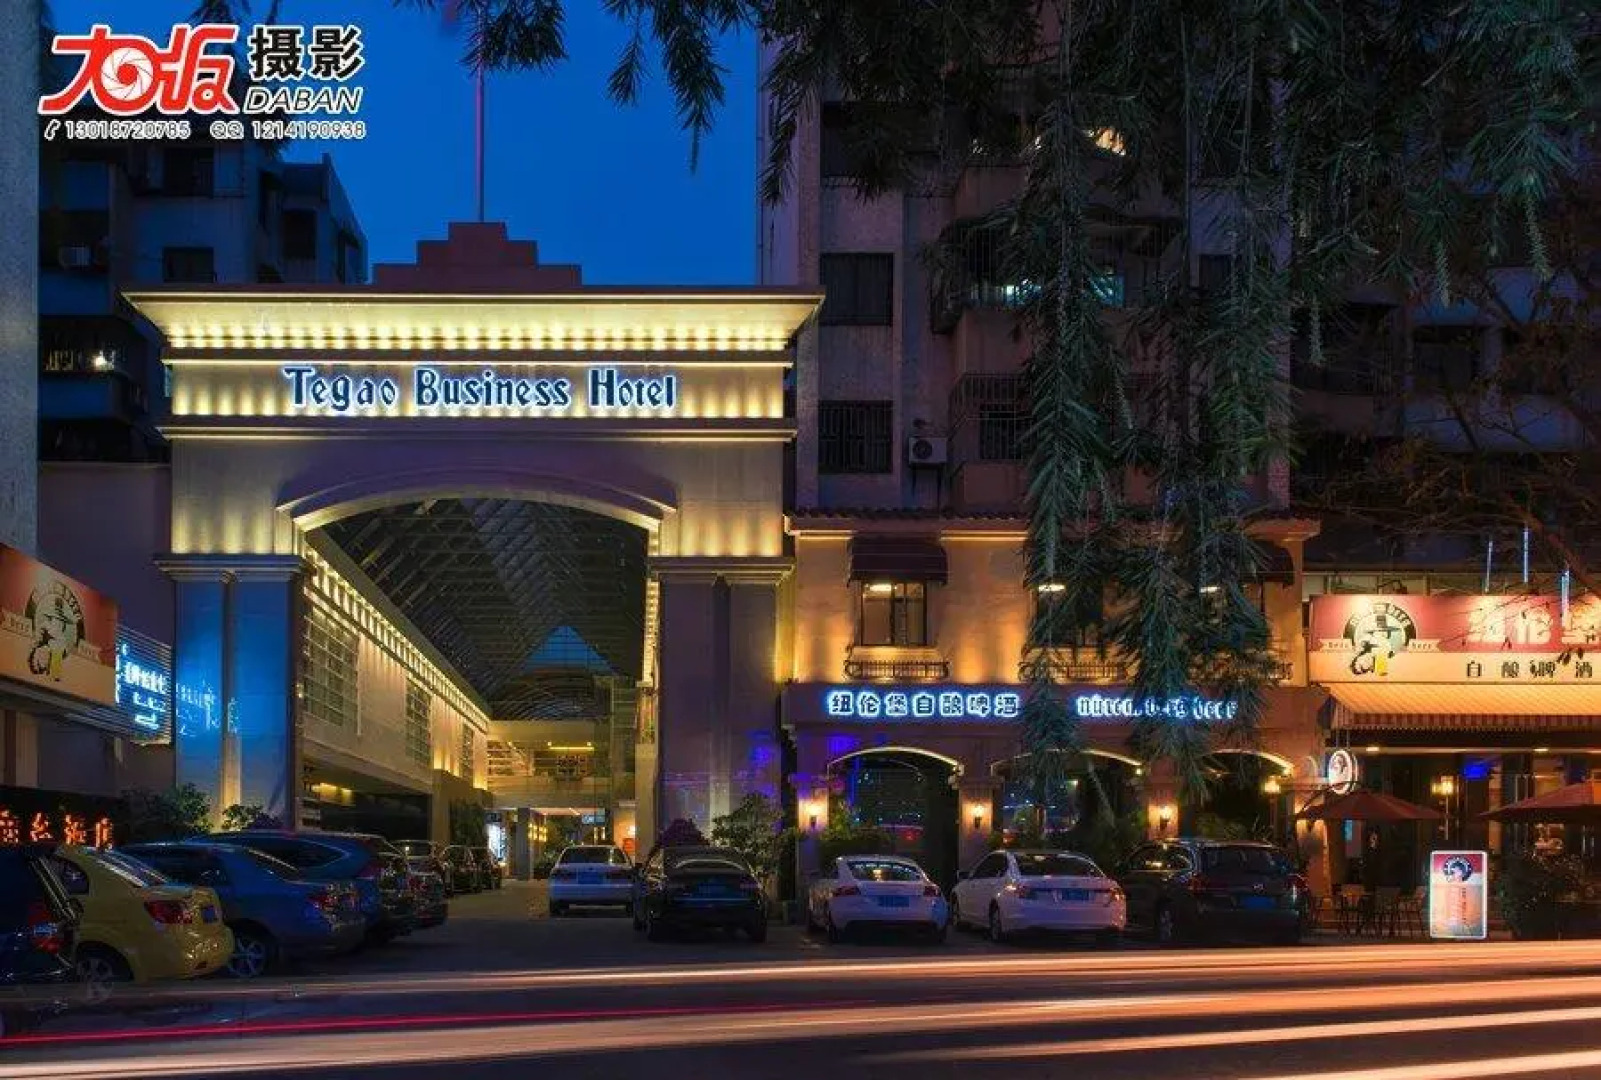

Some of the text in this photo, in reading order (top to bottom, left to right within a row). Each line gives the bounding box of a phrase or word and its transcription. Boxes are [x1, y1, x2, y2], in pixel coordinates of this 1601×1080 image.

[283, 365, 678, 411] Tegao Business Hotel
[829, 691, 1019, 717] 纽伦堡自酿啤酒
